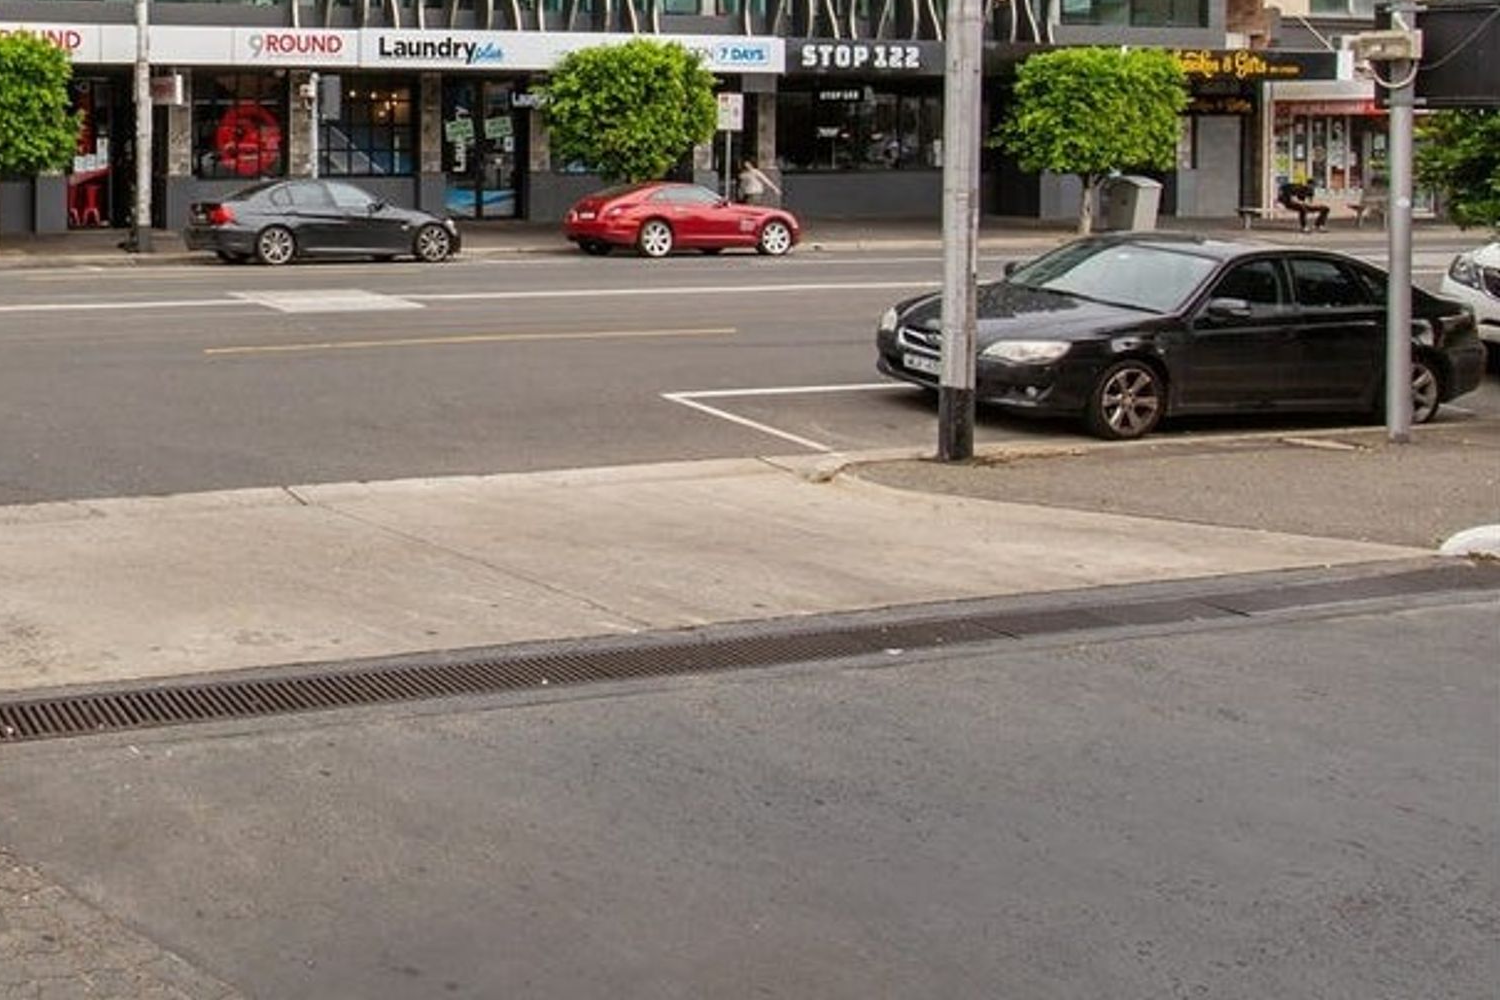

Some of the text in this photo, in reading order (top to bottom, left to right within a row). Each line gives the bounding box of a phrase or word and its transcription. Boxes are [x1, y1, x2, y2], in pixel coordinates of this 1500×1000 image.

[248, 34, 343, 57] 9ROUND
[378, 37, 476, 64] Laundry
[720, 47, 728, 60] 7
[730, 48, 765, 61] DAYS
[802, 44, 920, 69] STOP 122
